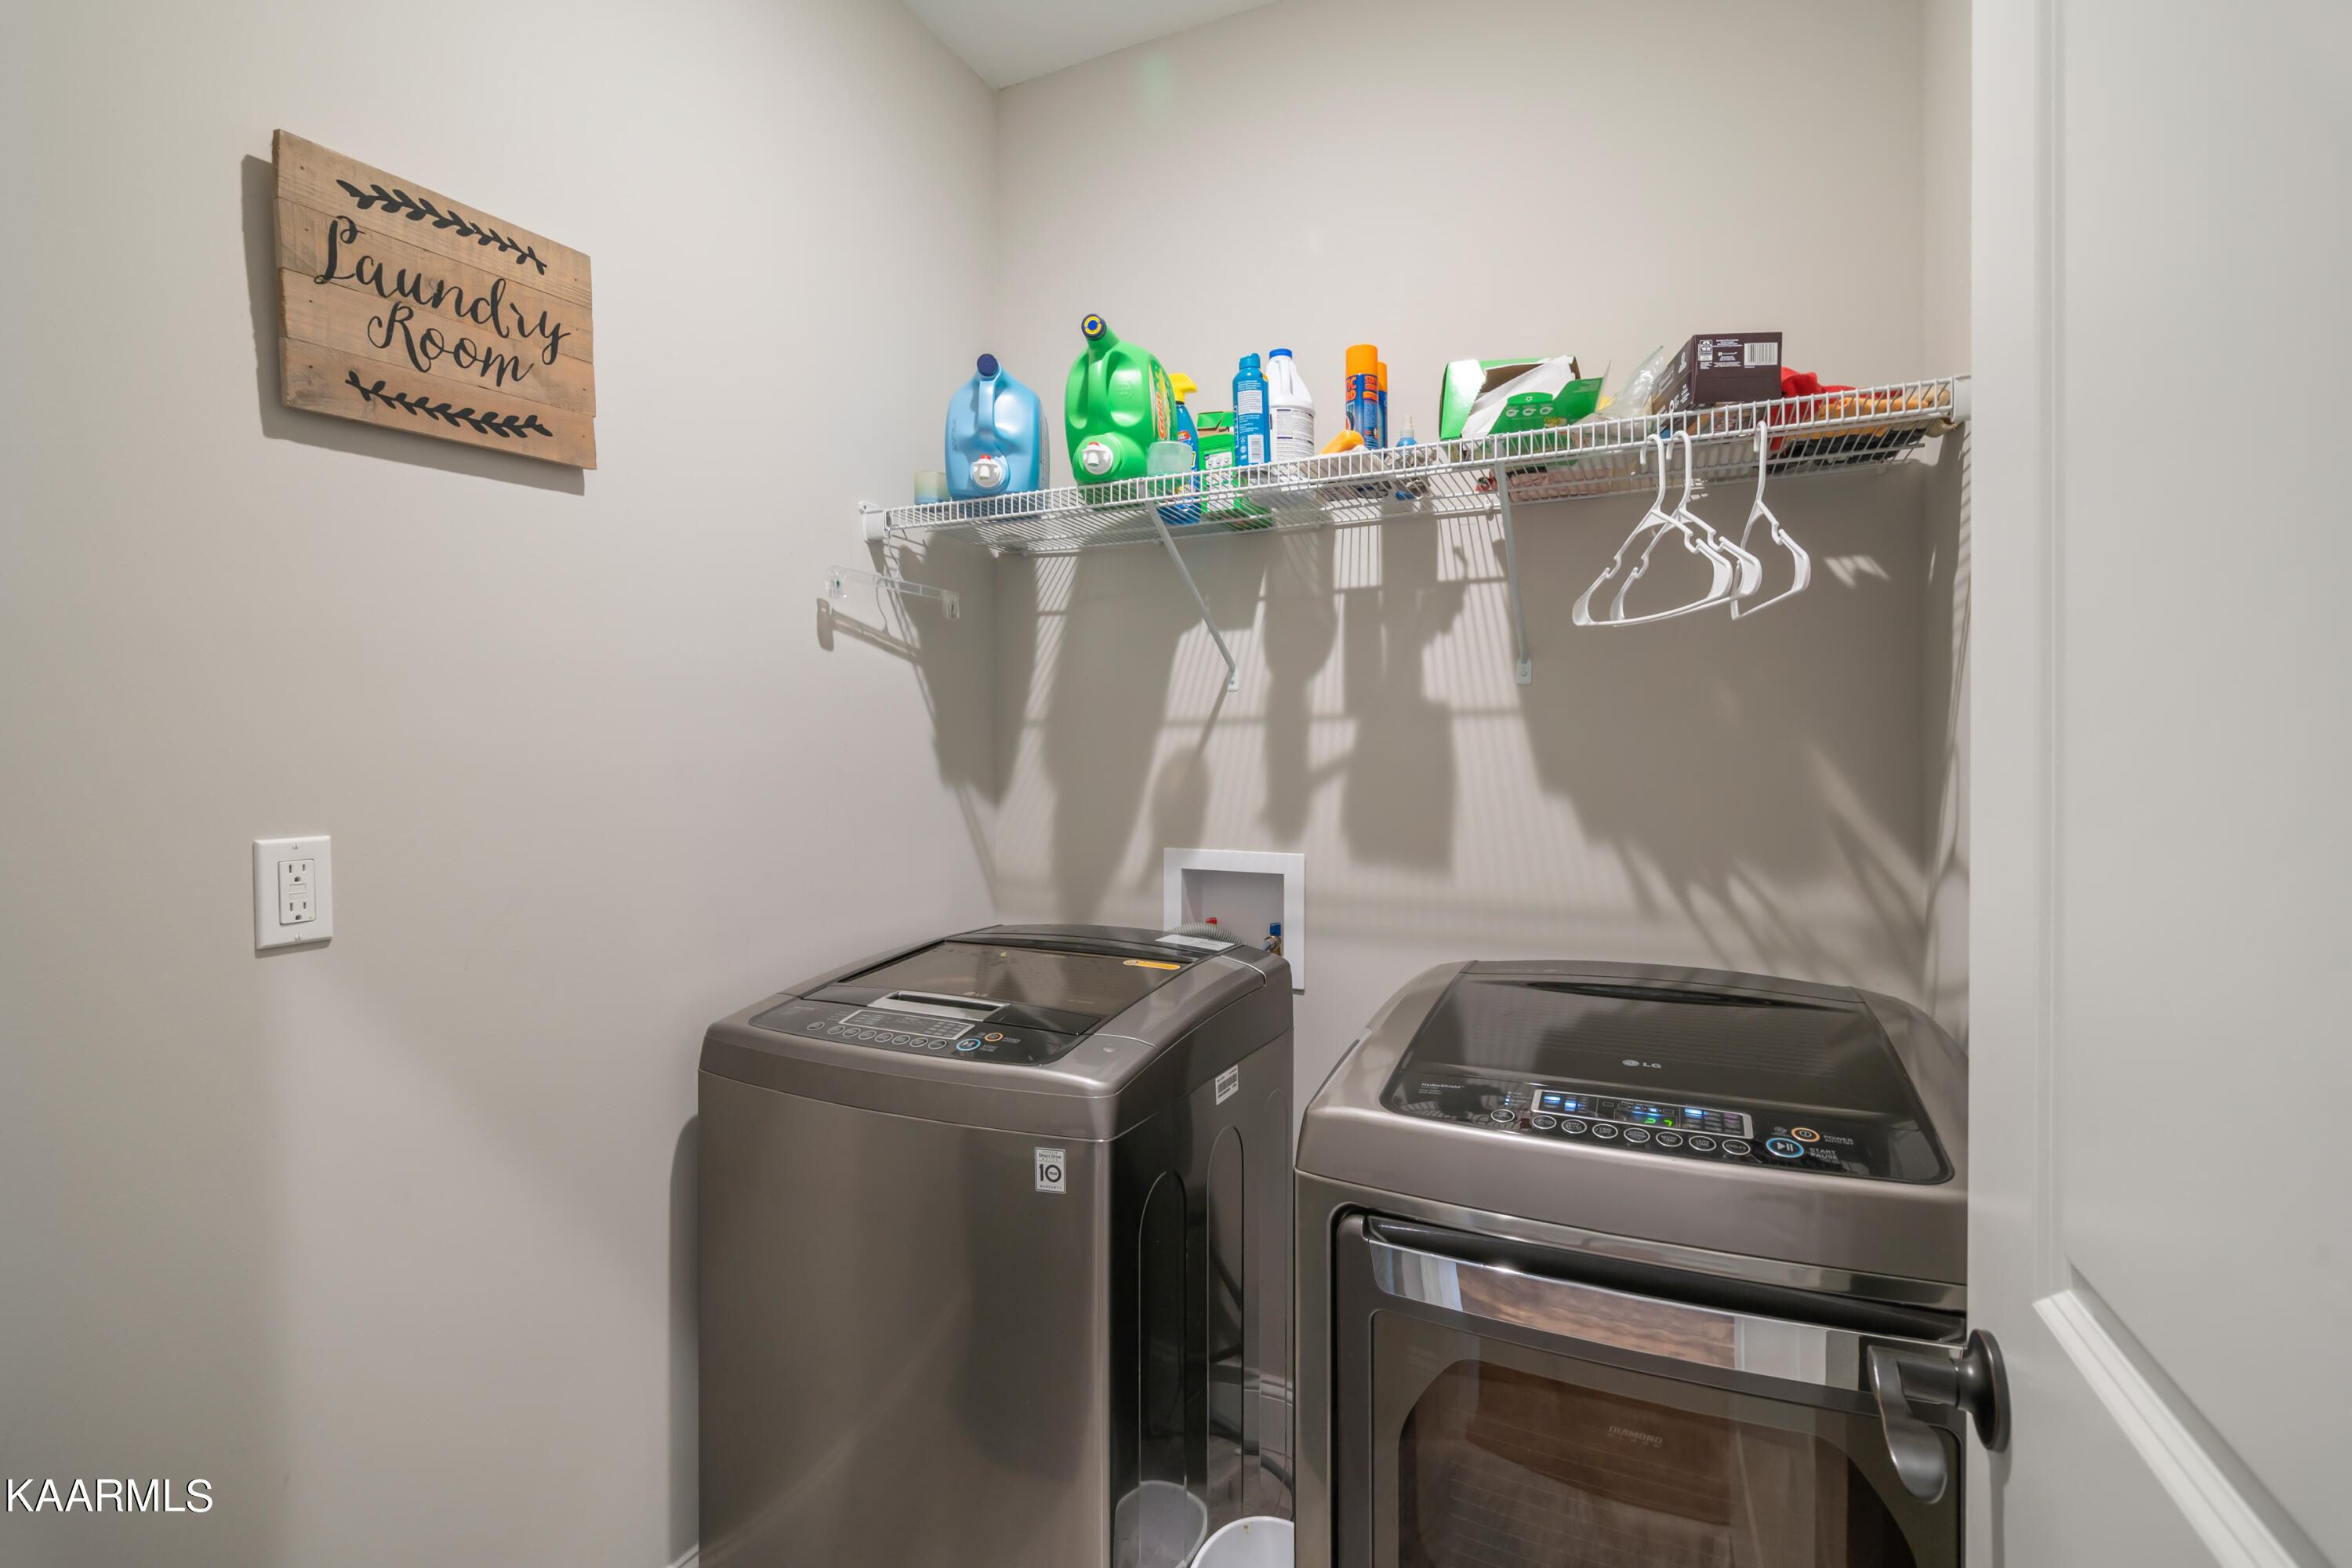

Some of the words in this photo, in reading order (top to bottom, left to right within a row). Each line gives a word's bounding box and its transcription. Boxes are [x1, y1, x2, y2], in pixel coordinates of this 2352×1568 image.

[314, 215, 571, 366] Laundry
[367, 301, 535, 387] Room
[1039, 1164, 1062, 1182] 10
[1608, 1425, 1663, 1444] DIAMOND
